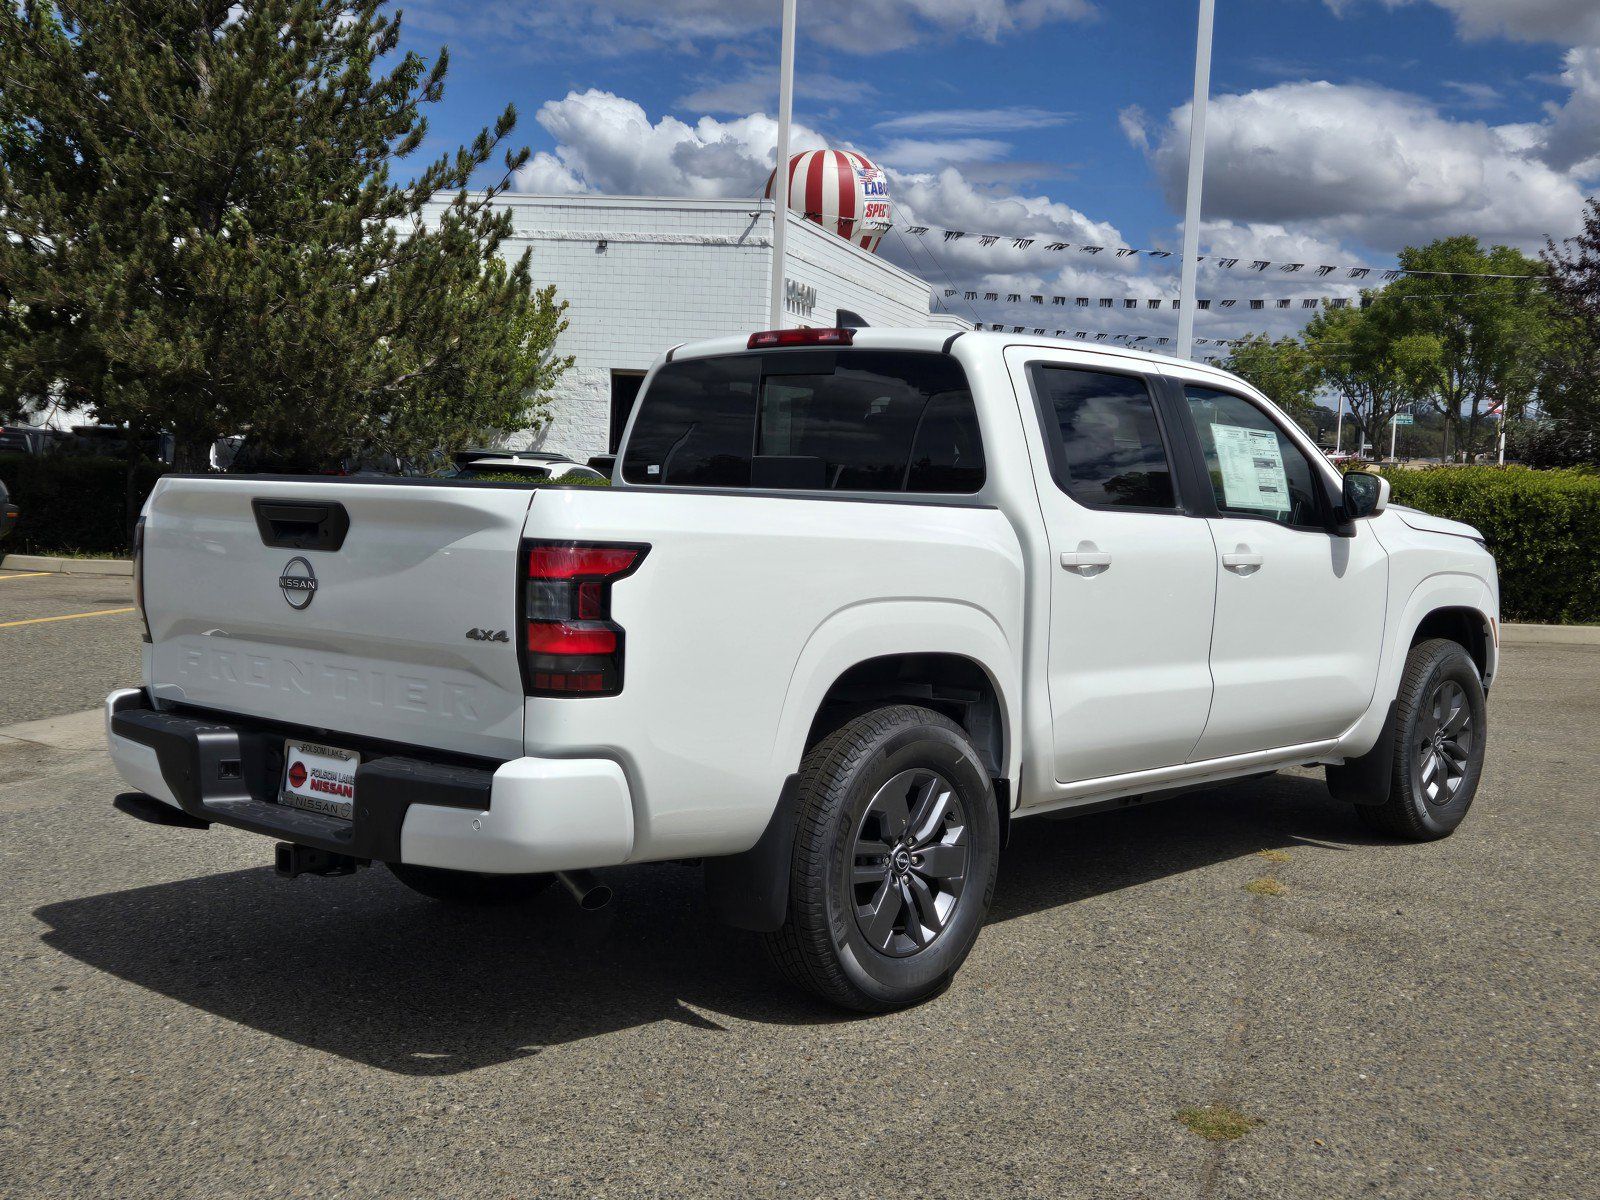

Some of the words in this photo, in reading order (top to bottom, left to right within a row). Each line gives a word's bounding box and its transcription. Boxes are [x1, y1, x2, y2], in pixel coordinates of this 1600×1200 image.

[279, 577, 317, 590] NISSAN
[175, 644, 480, 721] FRONTIER
[302, 743, 326, 755] FOLSOM
[327, 748, 344, 758] LAKE
[310, 768, 338, 782] FOLSOM
[310, 779, 354, 799] NISSAN
[295, 796, 338, 814] NISSAN
